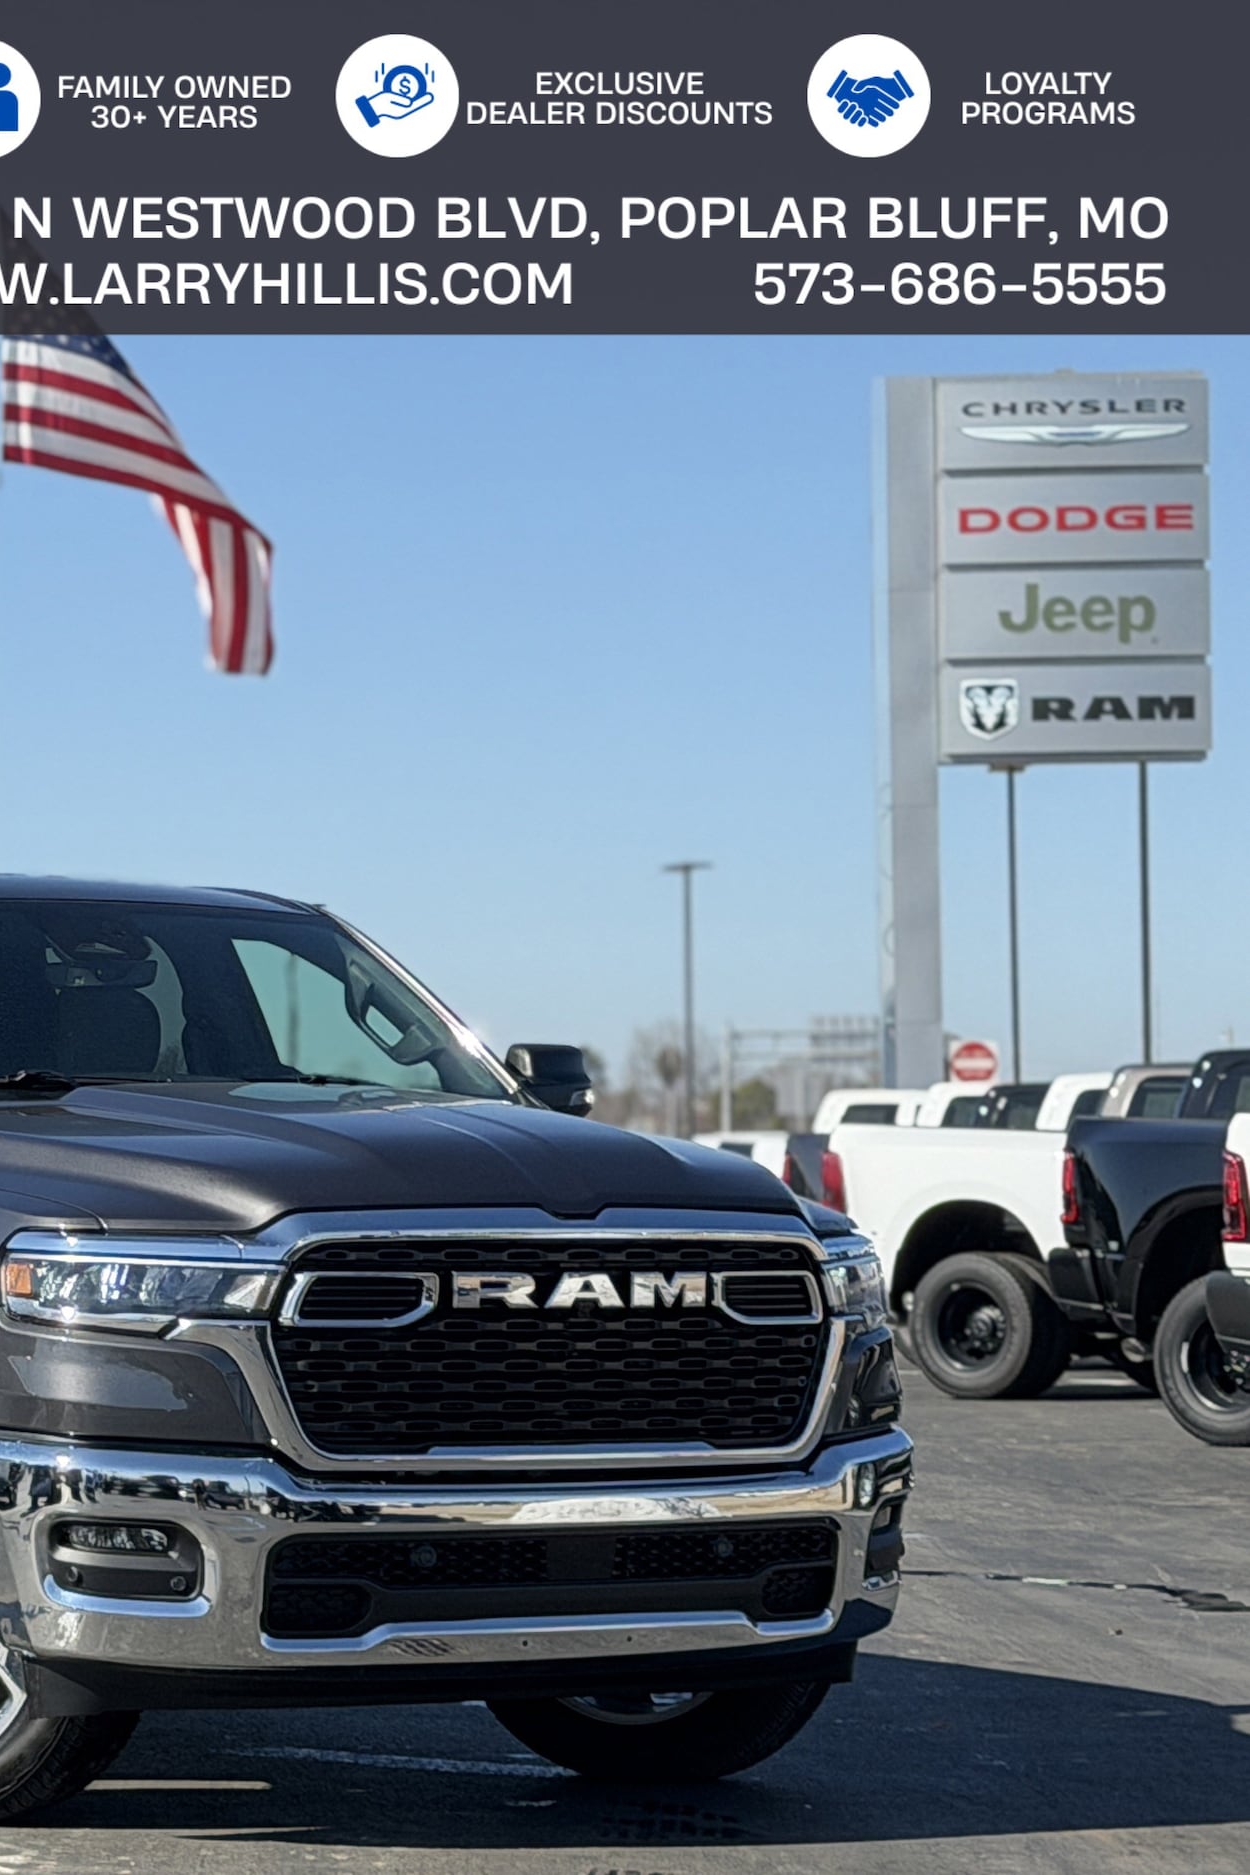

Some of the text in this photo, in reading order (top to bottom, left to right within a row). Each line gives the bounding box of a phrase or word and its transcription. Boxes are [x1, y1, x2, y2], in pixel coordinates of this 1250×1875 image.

[961, 398, 1188, 417] CHRYSLER
[958, 505, 1194, 534] DODGE
[998, 583, 1157, 644] Jeep
[1031, 696, 1196, 721] RAM
[452, 1271, 707, 1309] RAM
